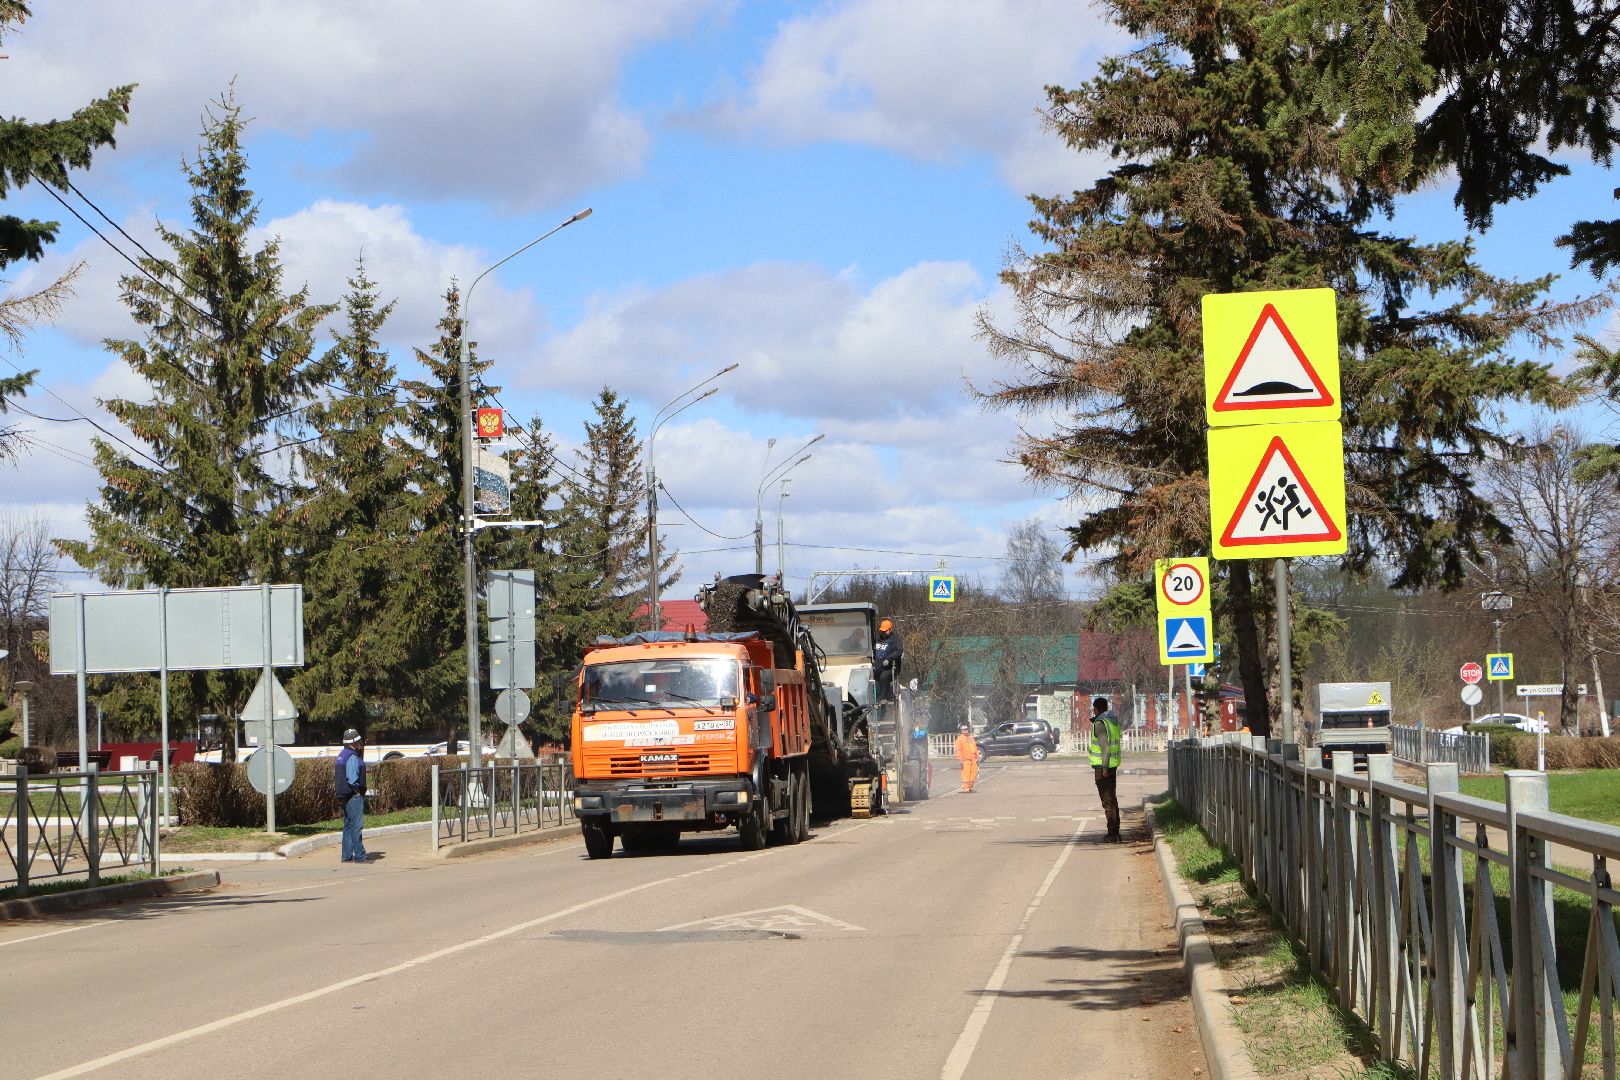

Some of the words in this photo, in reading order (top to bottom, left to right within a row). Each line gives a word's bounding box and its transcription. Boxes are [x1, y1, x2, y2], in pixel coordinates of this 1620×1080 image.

[1173, 575, 1193, 591] 20
[1462, 669, 1480, 677] STOP
[640, 754, 678, 762] KAMAZ
